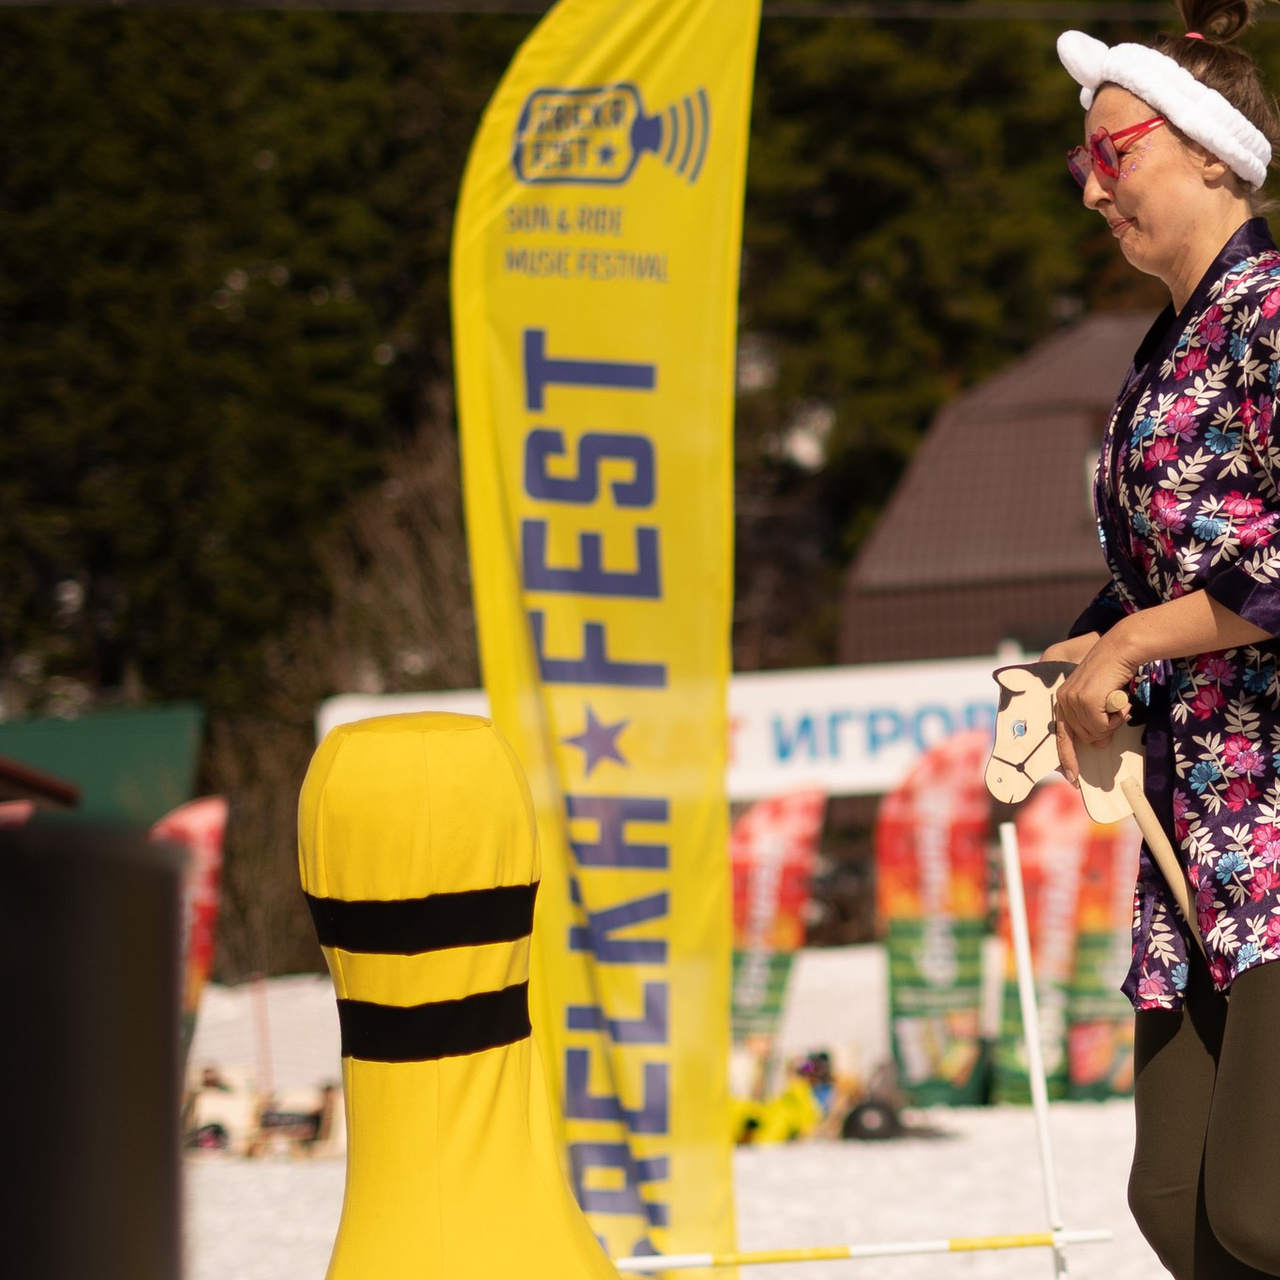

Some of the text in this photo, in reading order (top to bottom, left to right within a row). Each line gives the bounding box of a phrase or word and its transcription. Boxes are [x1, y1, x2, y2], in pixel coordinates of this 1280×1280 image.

[506, 204, 624, 236] SUN & RIDE
[506, 245, 669, 283] MUSIC FESTIVAL
[520, 328, 667, 688] FEST
